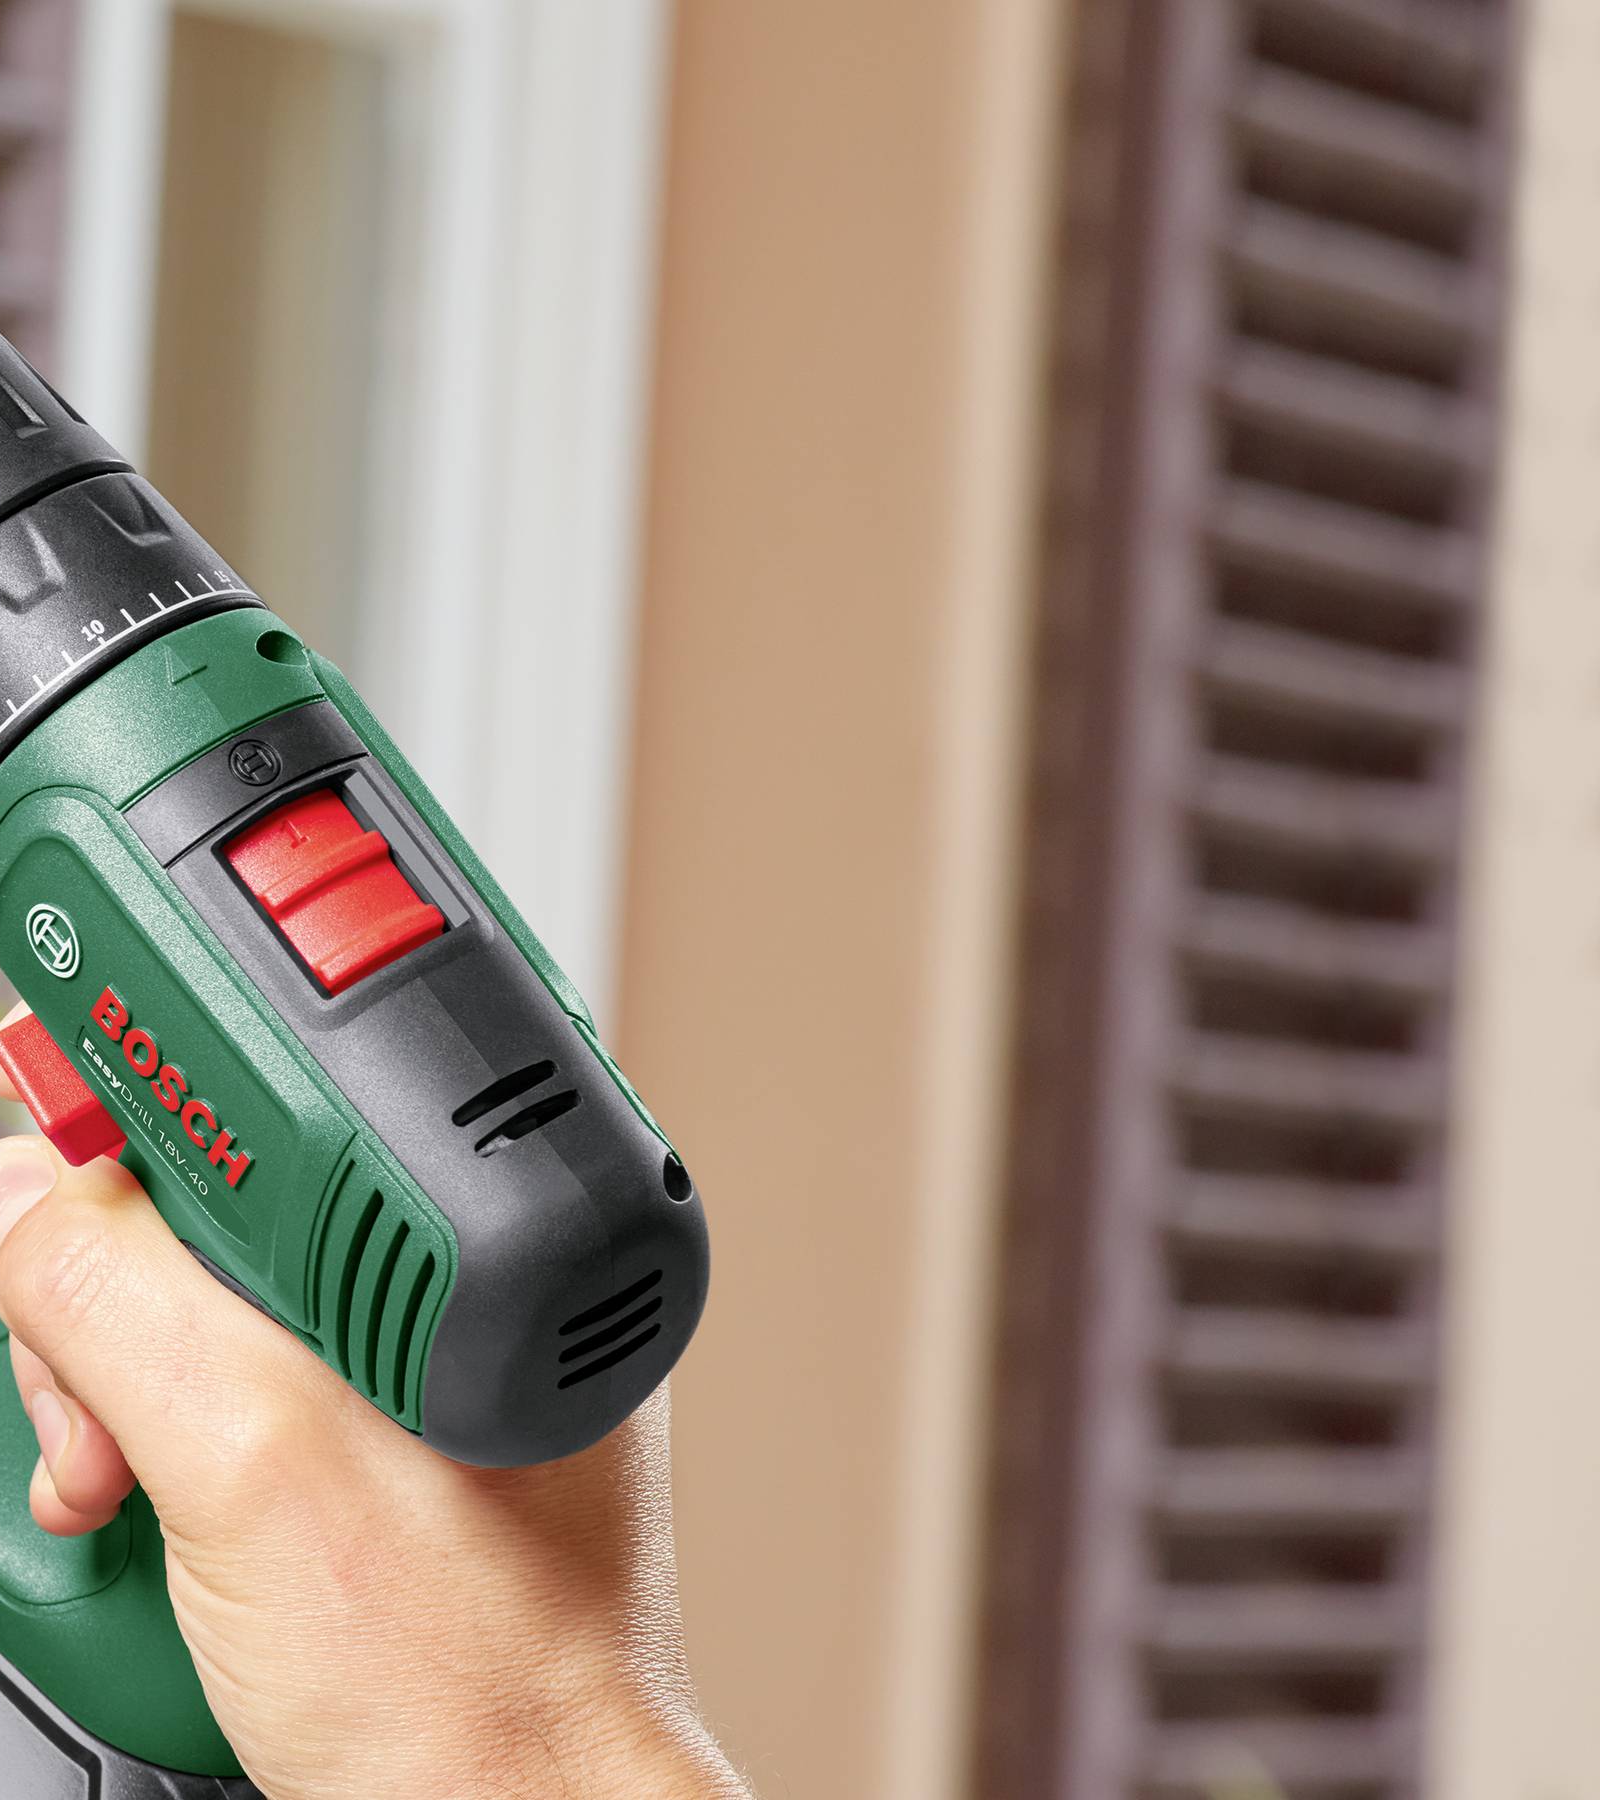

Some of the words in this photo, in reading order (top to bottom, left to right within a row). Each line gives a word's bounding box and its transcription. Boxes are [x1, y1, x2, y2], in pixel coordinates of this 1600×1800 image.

[80, 619, 106, 643] 10
[82, 1037, 154, 1131] EasyDrill
[158, 1130, 209, 1196] 18V-40
[90, 984, 253, 1188] BOSCH
